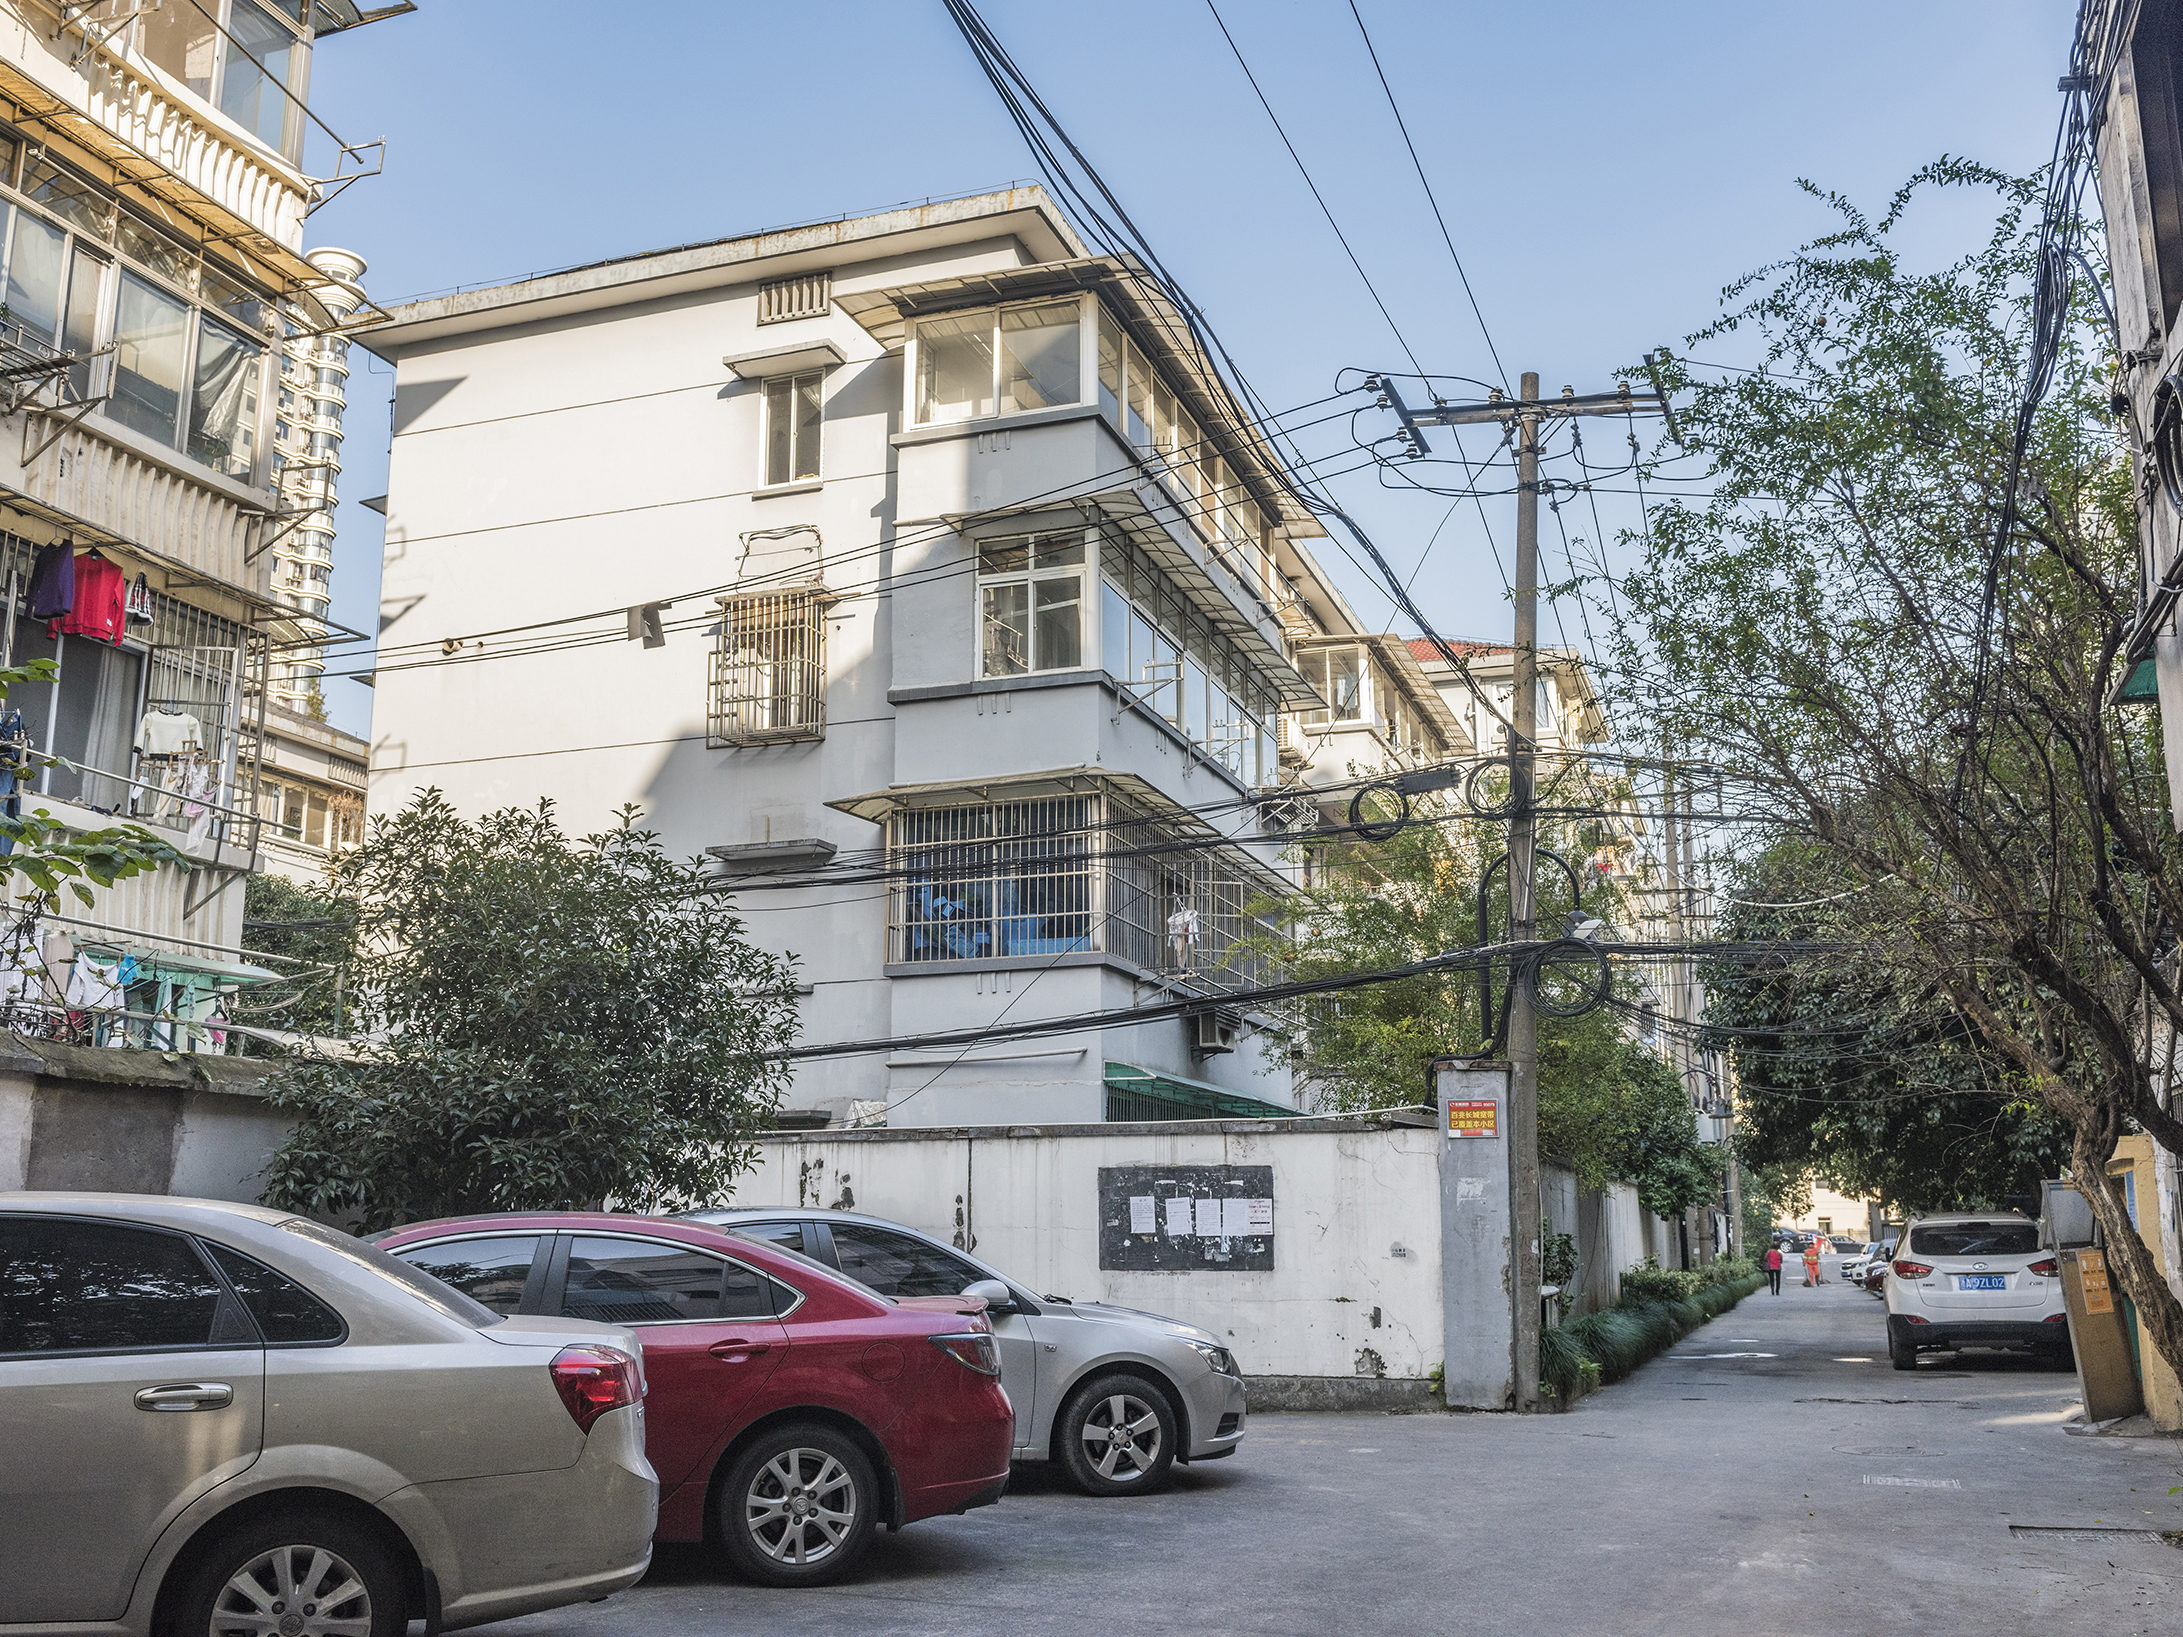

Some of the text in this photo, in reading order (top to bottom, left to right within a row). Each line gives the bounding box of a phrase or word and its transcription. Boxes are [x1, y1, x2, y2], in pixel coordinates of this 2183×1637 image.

[1451, 1120, 1495, 1128] 已覆盖本小区
